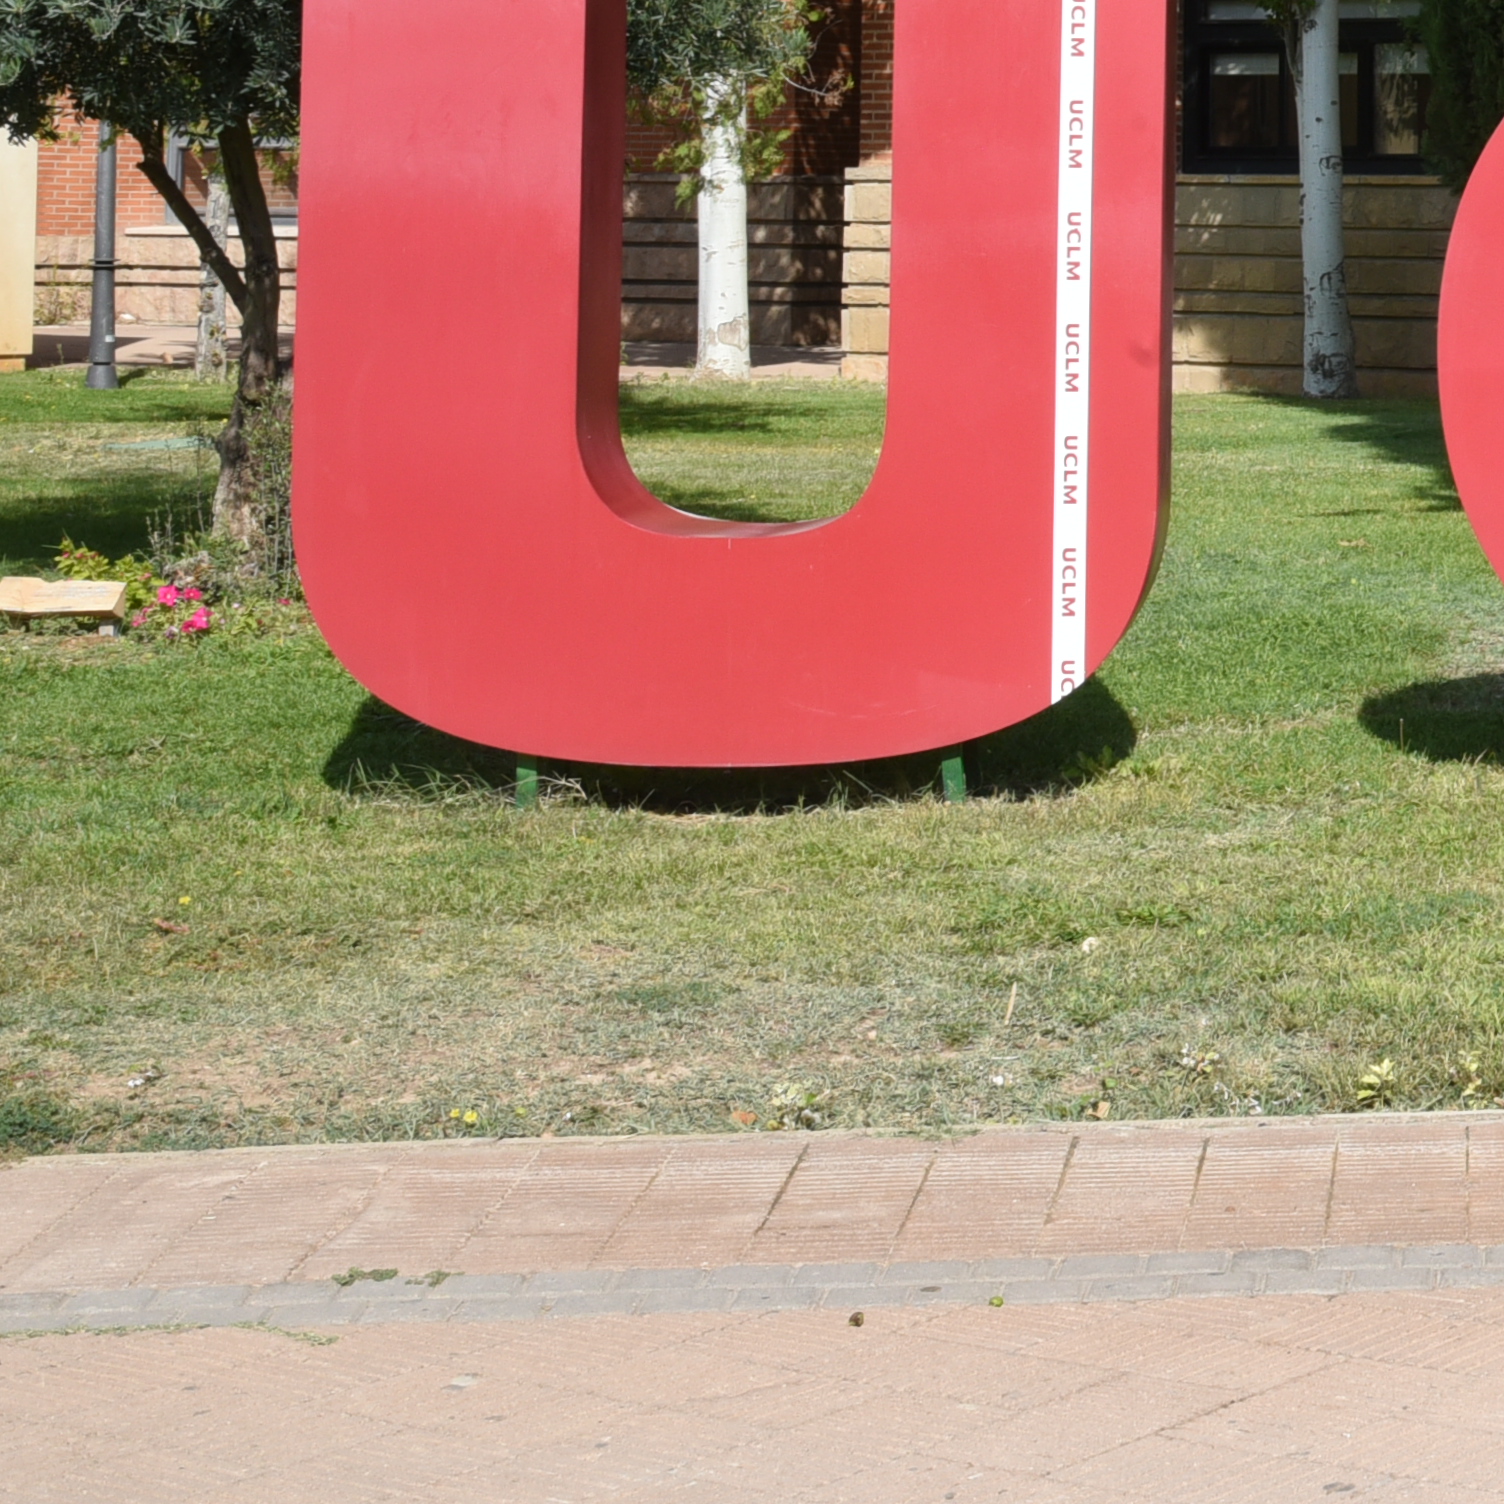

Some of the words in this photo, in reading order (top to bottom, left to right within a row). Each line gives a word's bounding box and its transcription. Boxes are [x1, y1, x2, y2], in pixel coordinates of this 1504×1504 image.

[1068, 100, 1084, 169] UCLM
[1066, 212, 1082, 281] UCLM
[1064, 323, 1080, 393] UCLM
[1062, 435, 1079, 505] UCLM
[1061, 547, 1077, 617] UCLM
